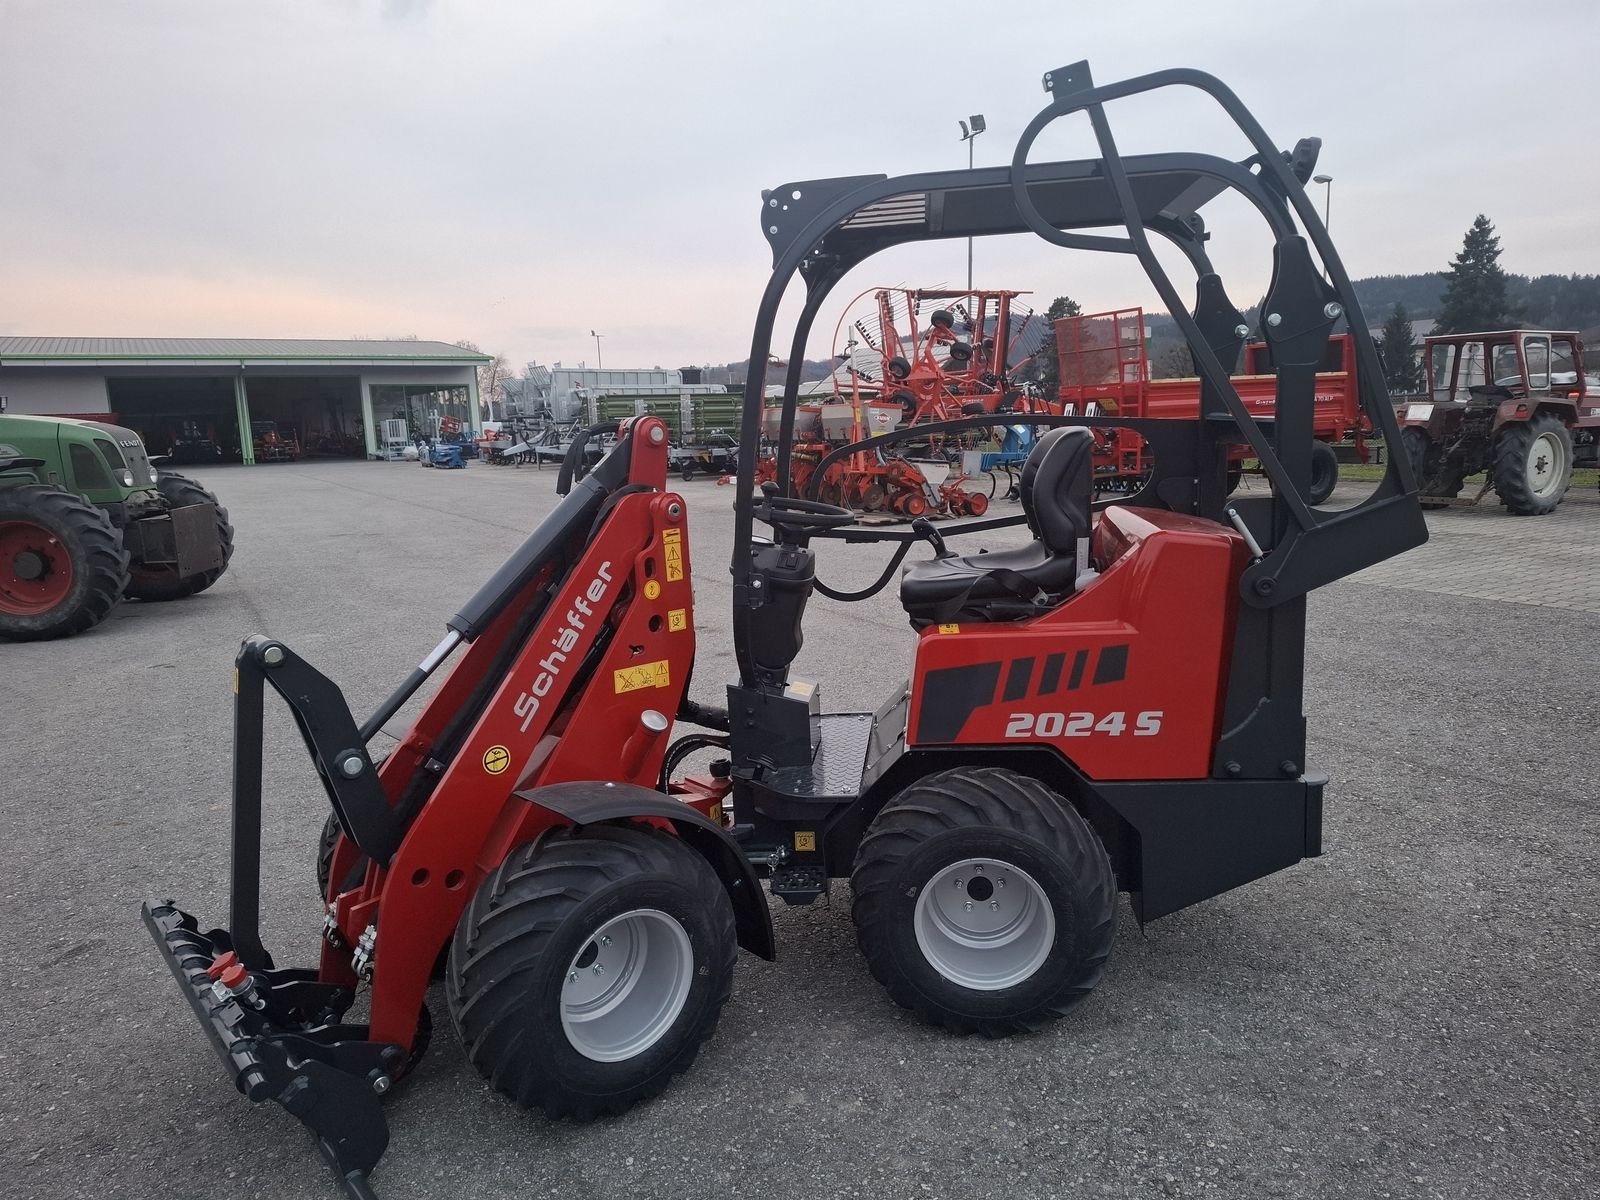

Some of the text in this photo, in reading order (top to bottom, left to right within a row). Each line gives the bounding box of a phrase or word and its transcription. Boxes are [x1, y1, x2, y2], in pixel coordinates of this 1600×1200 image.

[513, 560, 612, 733] Schäffer
[1005, 711, 1164, 738] 2024 S
